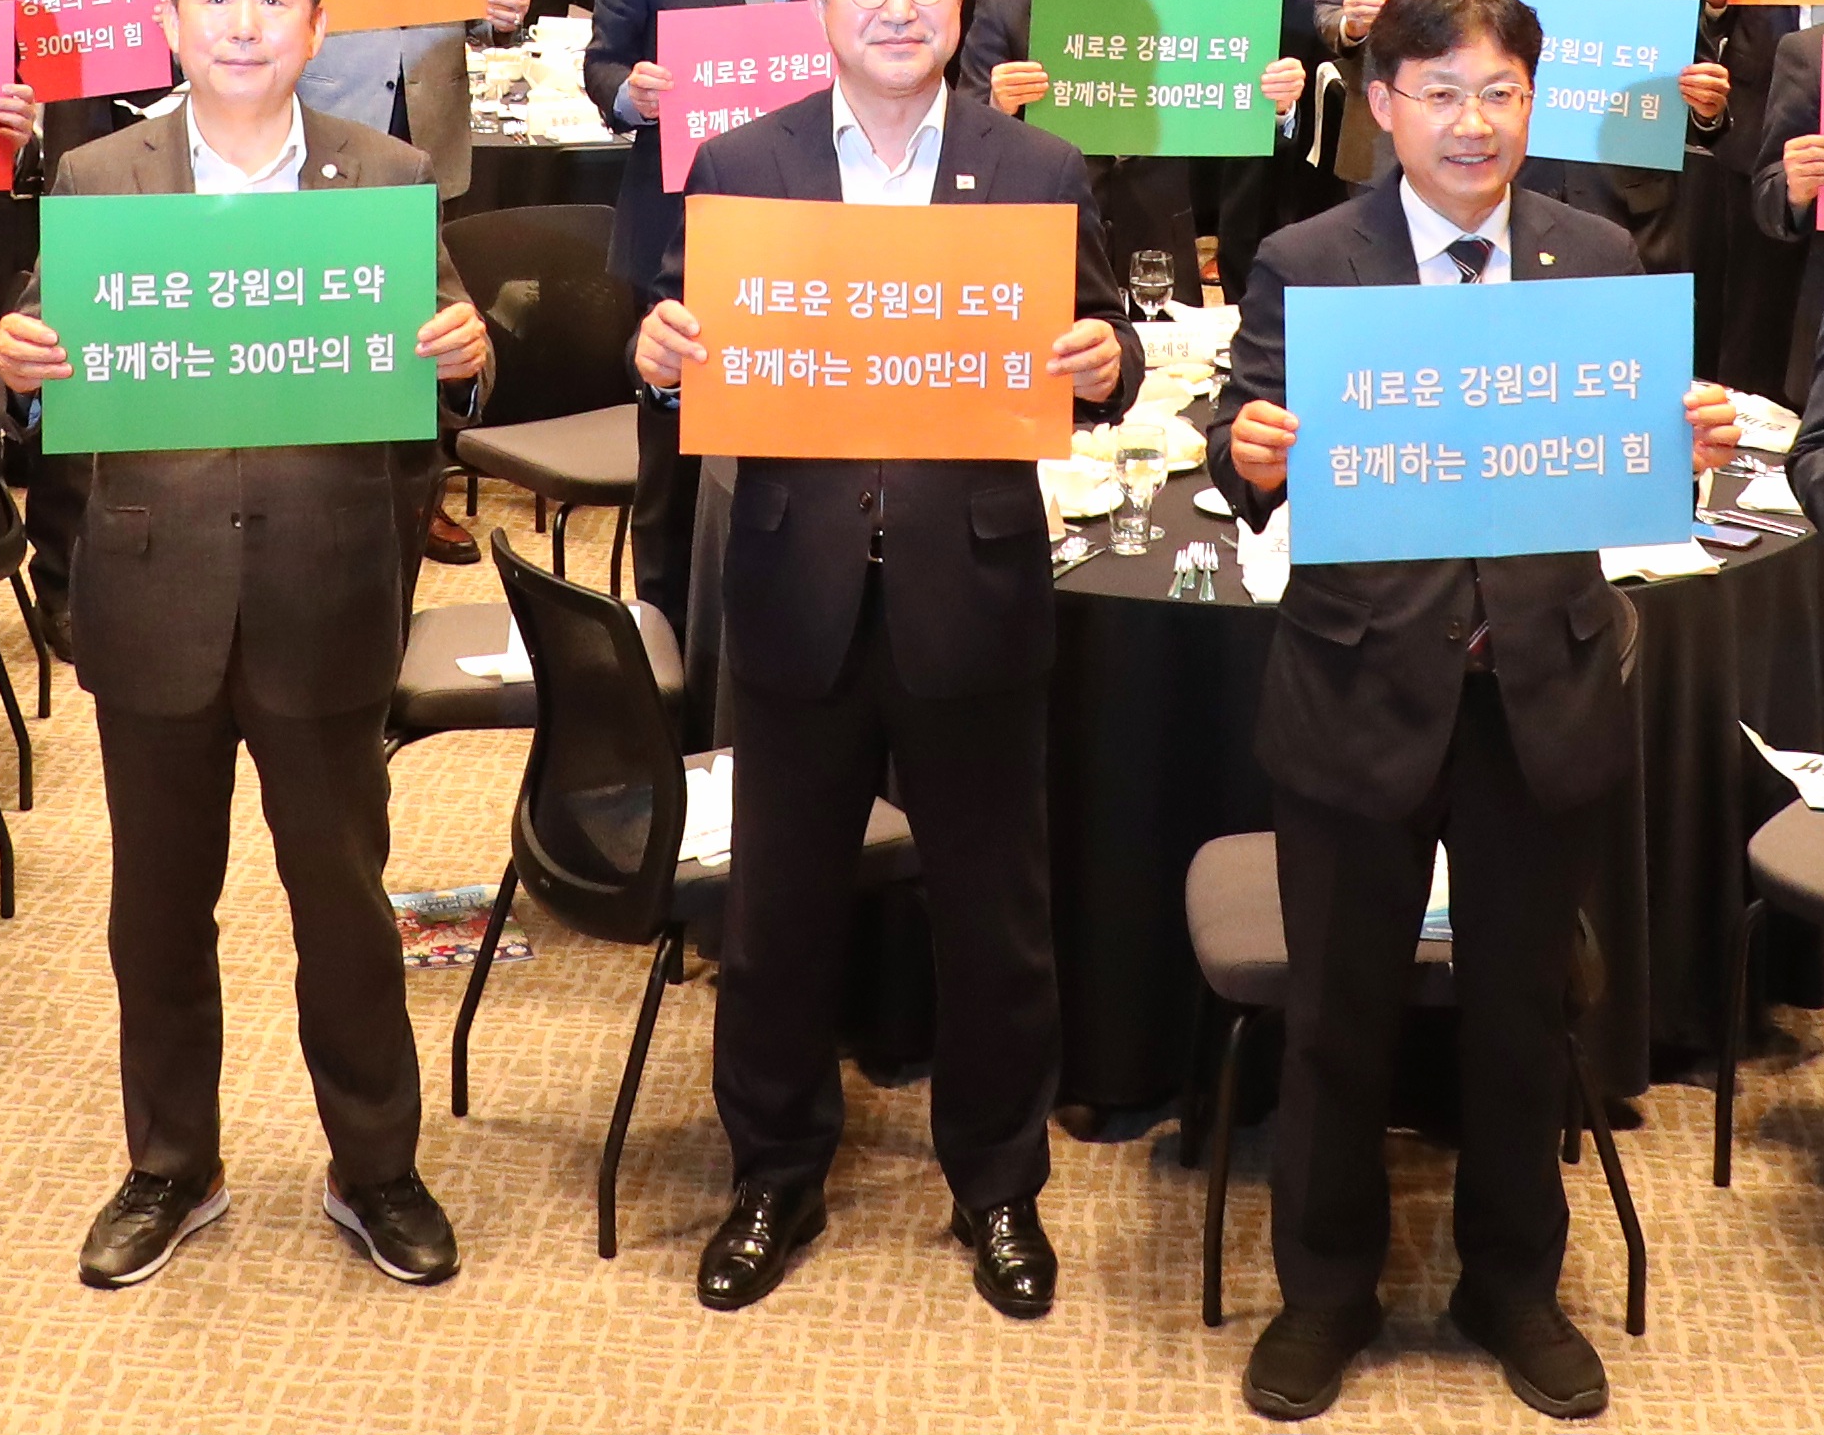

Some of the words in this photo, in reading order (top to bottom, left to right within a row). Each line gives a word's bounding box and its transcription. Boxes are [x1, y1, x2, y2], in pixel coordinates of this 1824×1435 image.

[37, 28, 105, 56] 300만의
[123, 22, 141, 47] 힘
[1063, 34, 1127, 60] 새로운
[1137, 36, 1198, 62] 강원의
[1207, 37, 1248, 63] 도약
[693, 58, 758, 87] 새로운
[768, 52, 831, 82] 강원의
[1612, 45, 1658, 72] 도약
[1053, 80, 1138, 108] 함께하는
[1145, 83, 1224, 109] 300만의
[1233, 83, 1252, 109] 힘
[1546, 87, 1630, 117] 300만의
[1640, 93, 1659, 120] 힘
[93, 272, 193, 311] 새로운
[208, 268, 303, 307] 강원의
[319, 265, 384, 303] 도약
[734, 277, 832, 316] 새로운
[846, 281, 941, 320] 강원의
[957, 283, 1023, 321] 도약
[82, 341, 214, 381] 함께하는
[229, 335, 349, 374] 300만의
[366, 333, 394, 371] 힘
[721, 346, 852, 387] 함께하는
[865, 351, 986, 388] 300만의
[1002, 352, 1030, 388] 힘
[1341, 368, 1444, 410] 새로운
[1459, 362, 1556, 406] 강원의
[1573, 359, 1640, 399] 도약
[1329, 442, 1466, 485] 함께하는
[1481, 434, 1604, 478] 300만의
[1621, 432, 1649, 473] 힘
